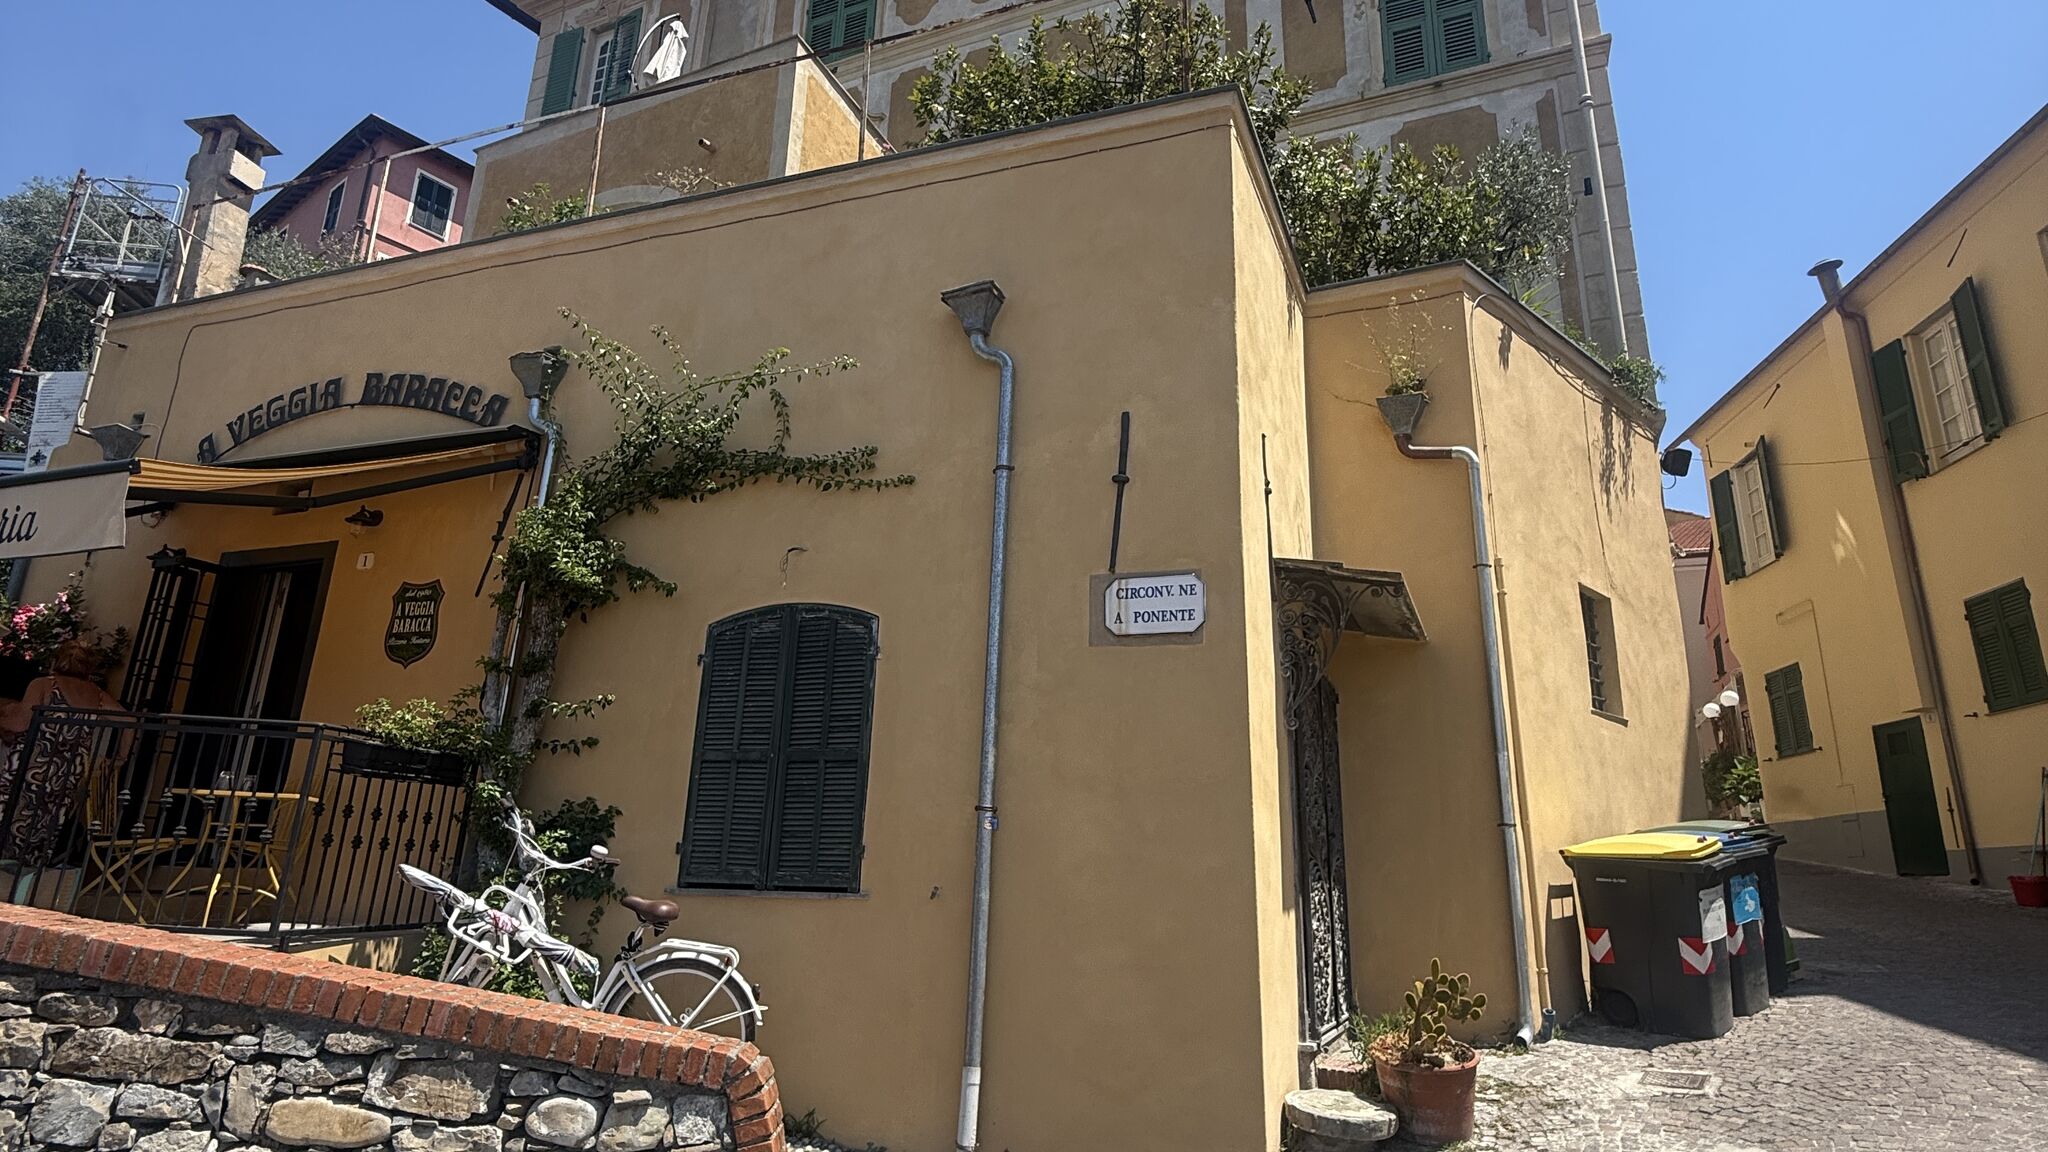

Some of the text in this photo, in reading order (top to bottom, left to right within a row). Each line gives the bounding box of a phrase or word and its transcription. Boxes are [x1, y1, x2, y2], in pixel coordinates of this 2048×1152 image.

[197, 372, 509, 464] A VEGGIA BARACCA
[0, 505, 38, 544] ria
[1116, 584, 1197, 600] CIRCONV. NE
[396, 601, 434, 617] A VEGGIA
[1114, 609, 1195, 624] A PONENTE
[392, 617, 431, 633] BARACCA
